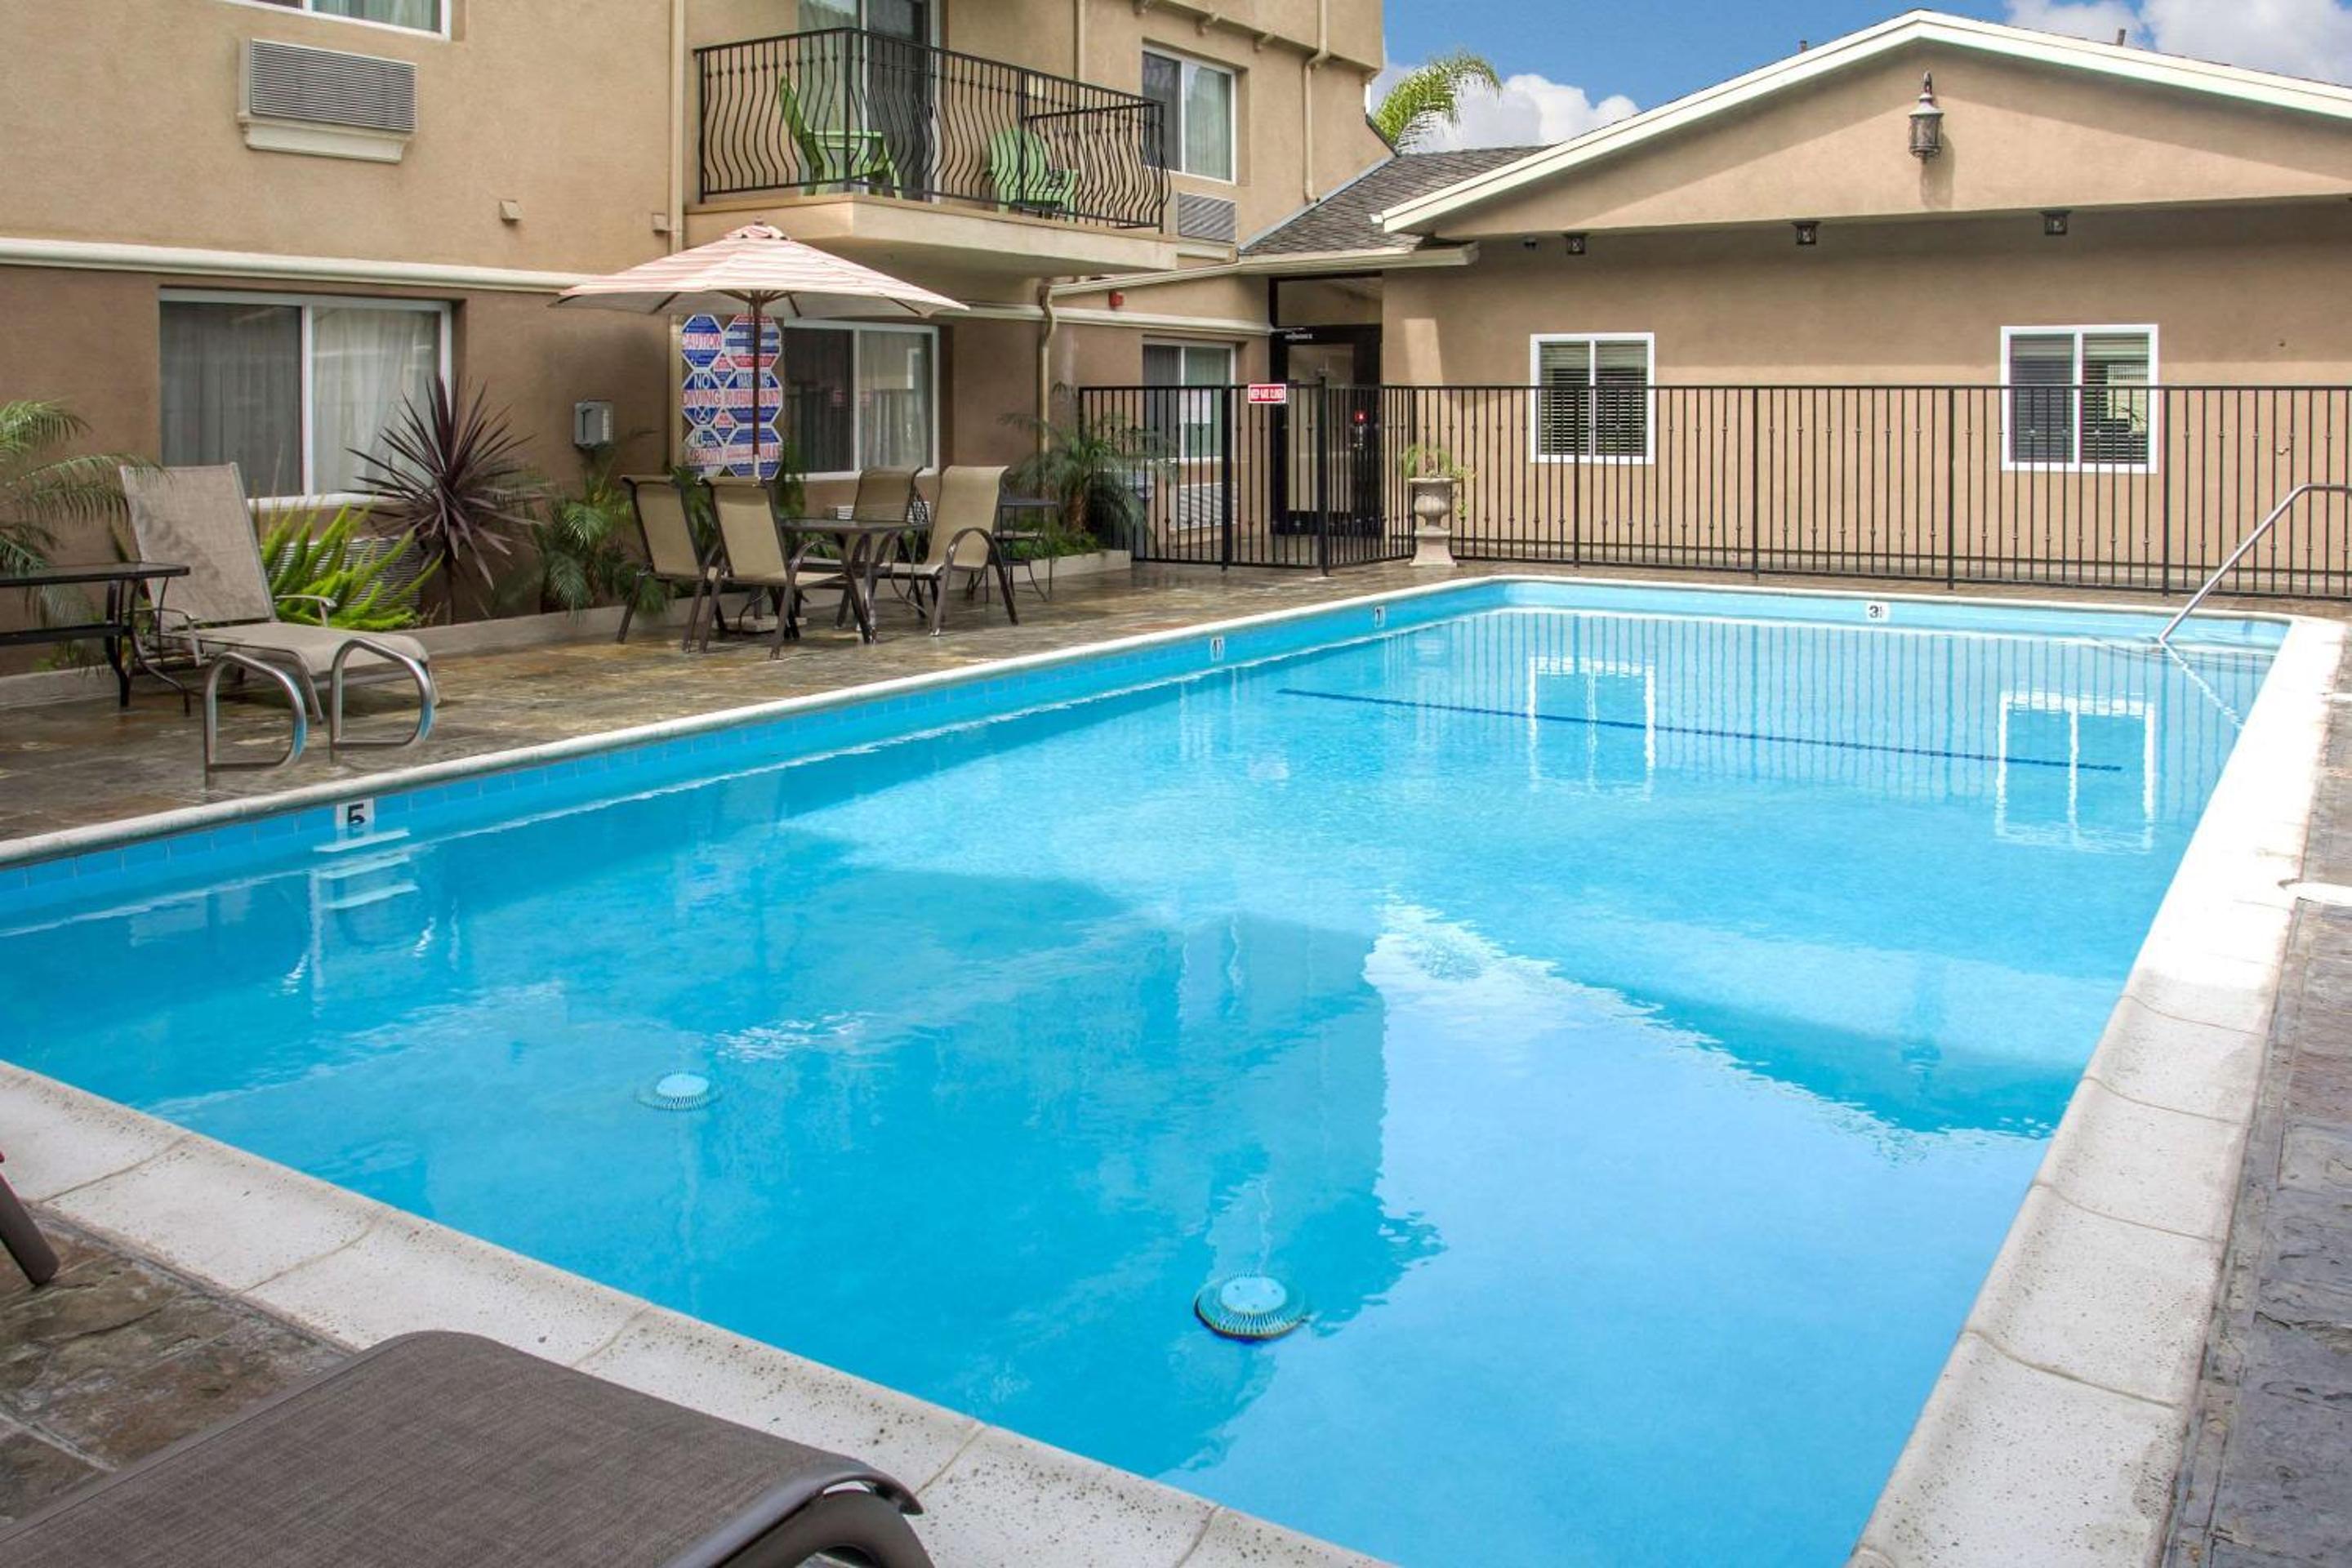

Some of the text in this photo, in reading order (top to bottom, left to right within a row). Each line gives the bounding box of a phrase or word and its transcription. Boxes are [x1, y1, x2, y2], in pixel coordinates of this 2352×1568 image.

[694, 373, 710, 389] NO
[681, 390, 720, 405] DIVING
[347, 803, 365, 828] 5
